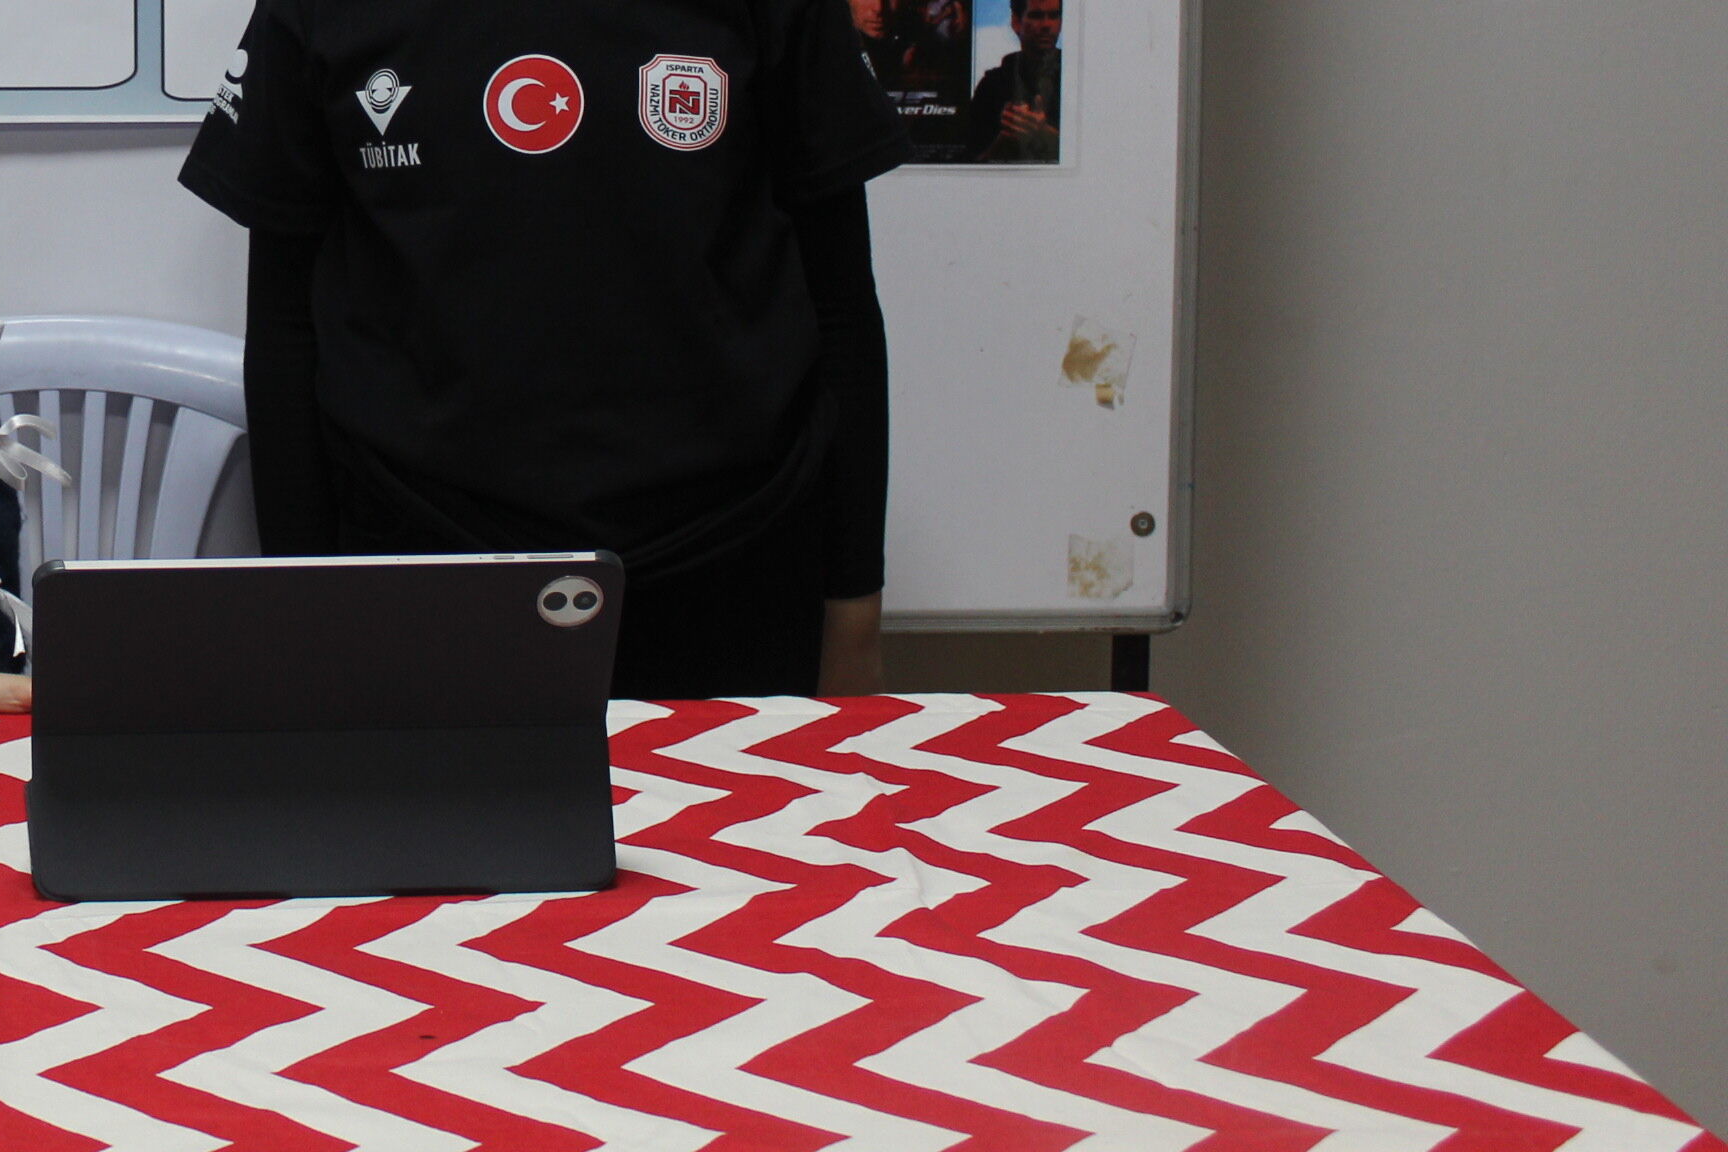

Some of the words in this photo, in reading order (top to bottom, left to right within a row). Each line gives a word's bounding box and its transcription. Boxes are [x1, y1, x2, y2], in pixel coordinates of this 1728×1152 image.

[666, 64, 704, 74] ISPARTA
[674, 116, 693, 124] 1992
[360, 142, 421, 169] TÜBİTAK
